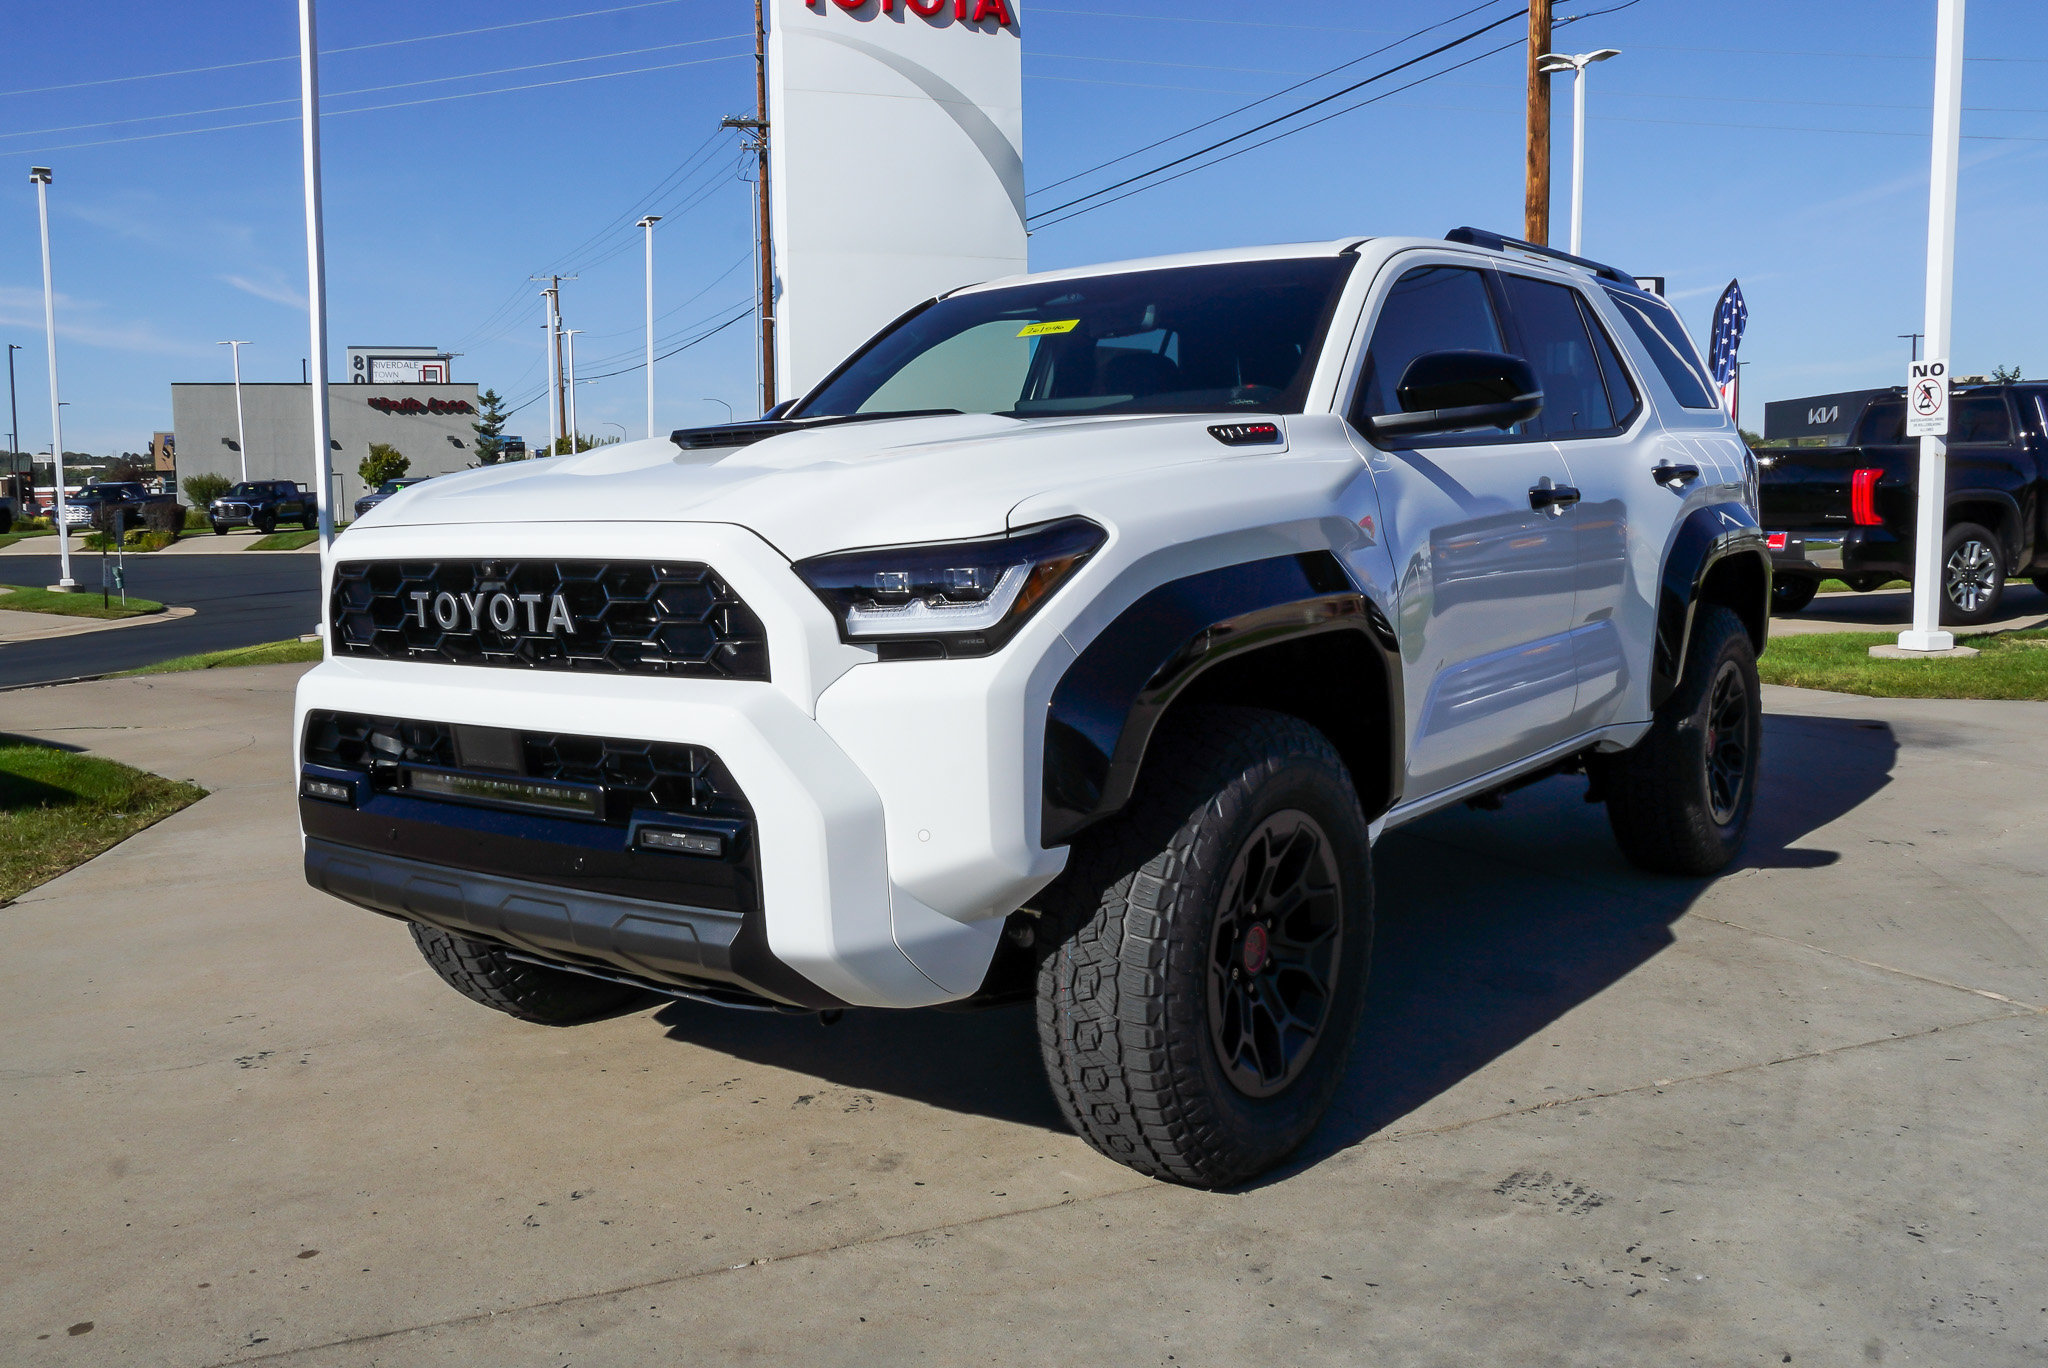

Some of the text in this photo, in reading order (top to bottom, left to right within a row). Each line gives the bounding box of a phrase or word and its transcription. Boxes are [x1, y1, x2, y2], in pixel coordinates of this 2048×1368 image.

[373, 361, 419, 369] RIVERDALE
[1912, 363, 1945, 378] NO
[1808, 406, 1838, 425] KIA
[410, 591, 575, 633] TOYOTA
